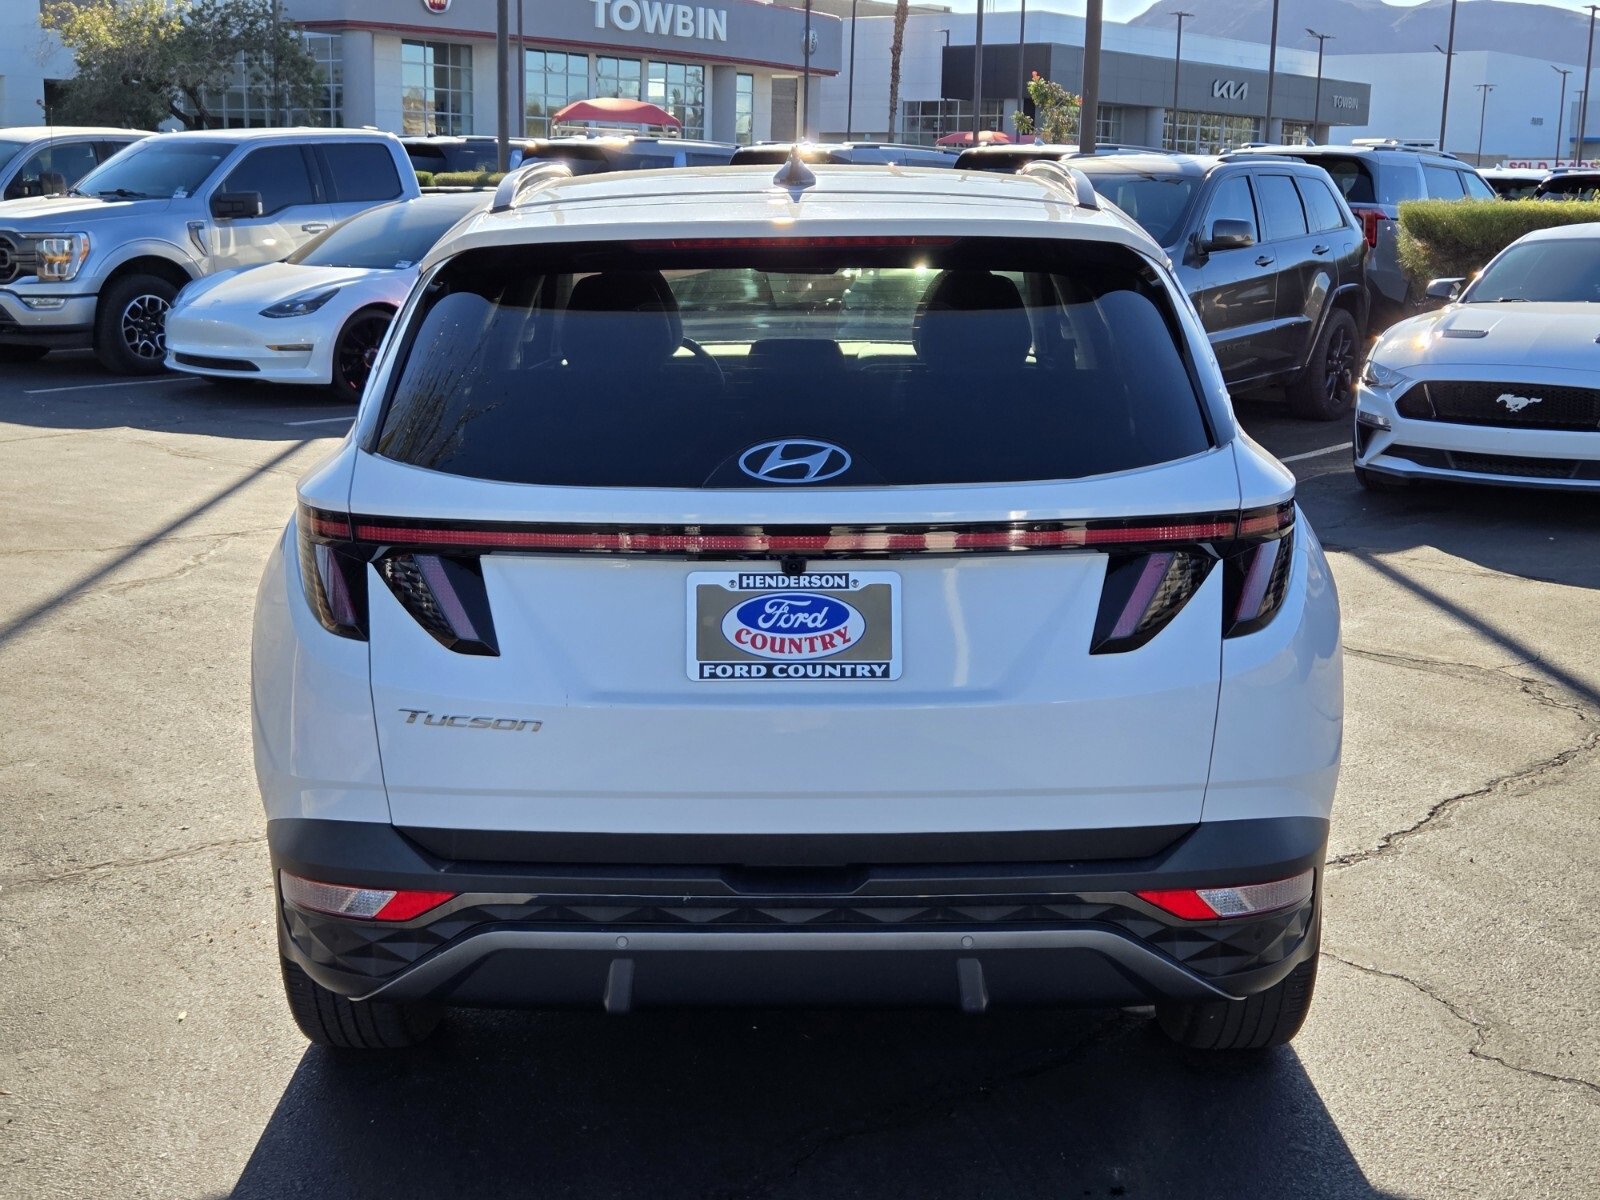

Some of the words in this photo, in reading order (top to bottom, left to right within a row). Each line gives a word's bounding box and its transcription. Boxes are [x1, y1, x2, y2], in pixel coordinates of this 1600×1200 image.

[588, 0, 728, 42] TOWBIN
[741, 575, 846, 588] HENDERSON
[757, 598, 829, 629] Ford
[734, 625, 852, 654] COUNTRY
[703, 664, 768, 678] FORD
[772, 664, 887, 678] COUNTRY
